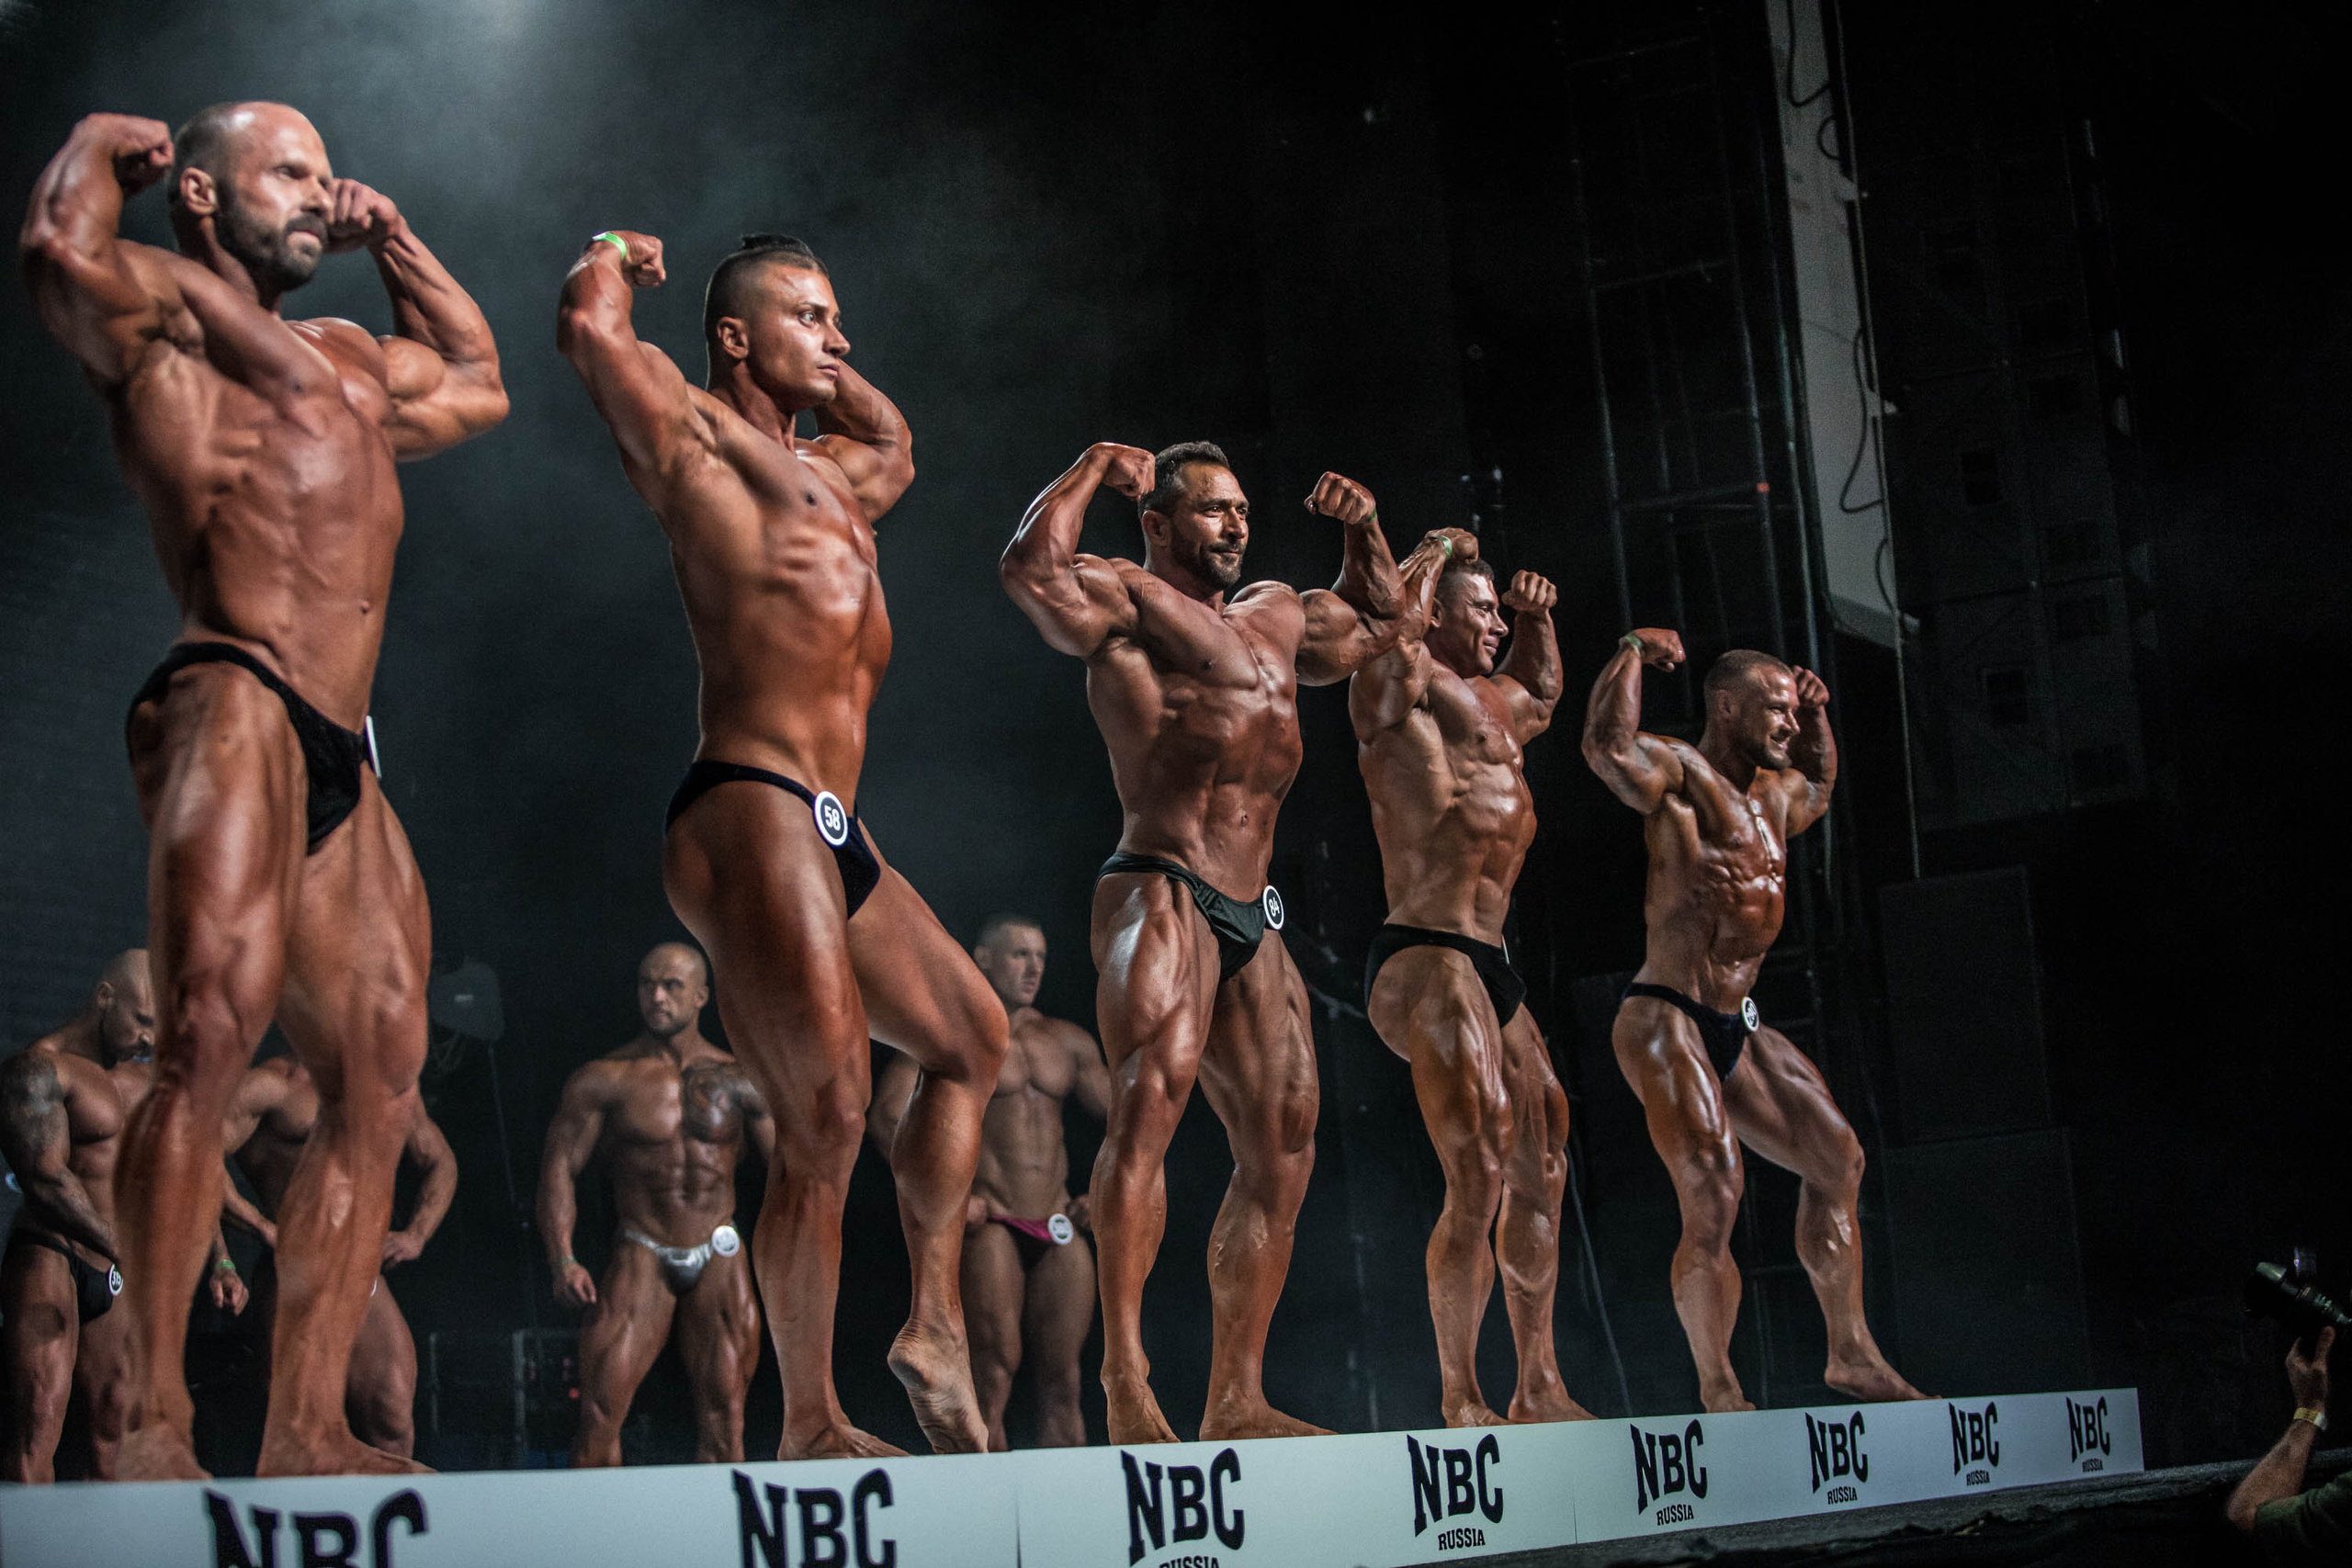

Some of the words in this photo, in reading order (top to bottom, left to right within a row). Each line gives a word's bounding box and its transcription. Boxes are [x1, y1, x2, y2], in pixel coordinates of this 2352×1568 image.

[824, 805, 841, 831] 58
[1804, 1411, 1868, 1494] NBC
[1949, 1402, 1999, 1476] NBC
[2065, 1396, 2110, 1462] NBC
[1408, 1434, 1503, 1537] NBC
[1630, 1419, 1707, 1515] NBC
[1827, 1486, 1858, 1505] RUSSIA
[1966, 1470, 1991, 1486] RUSSIA
[731, 1469, 897, 1568] NBC
[1121, 1448, 1245, 1567] NBC
[1438, 1528, 1486, 1551] RUSSIA
[1657, 1504, 1694, 1526] RUSSIA
[1159, 1556, 1219, 1568] USSIA
